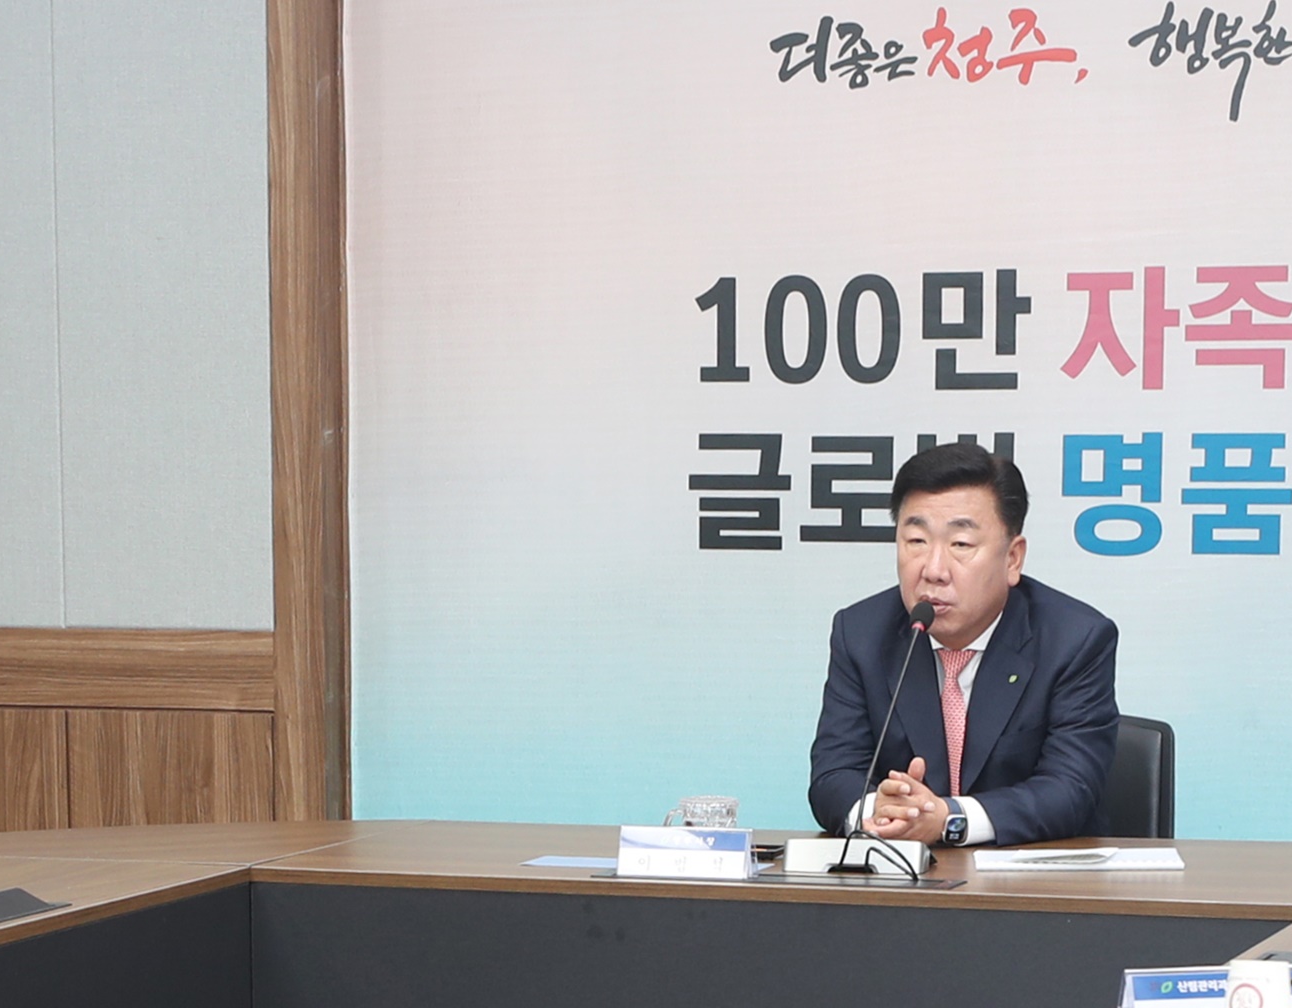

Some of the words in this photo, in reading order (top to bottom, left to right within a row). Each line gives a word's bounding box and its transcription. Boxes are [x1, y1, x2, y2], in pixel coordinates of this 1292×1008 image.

[769, 16, 918, 89] 더좋은
[922, 7, 1089, 86] 청주,
[694, 268, 1032, 390] 100만
[688, 431, 1015, 550] 글로
